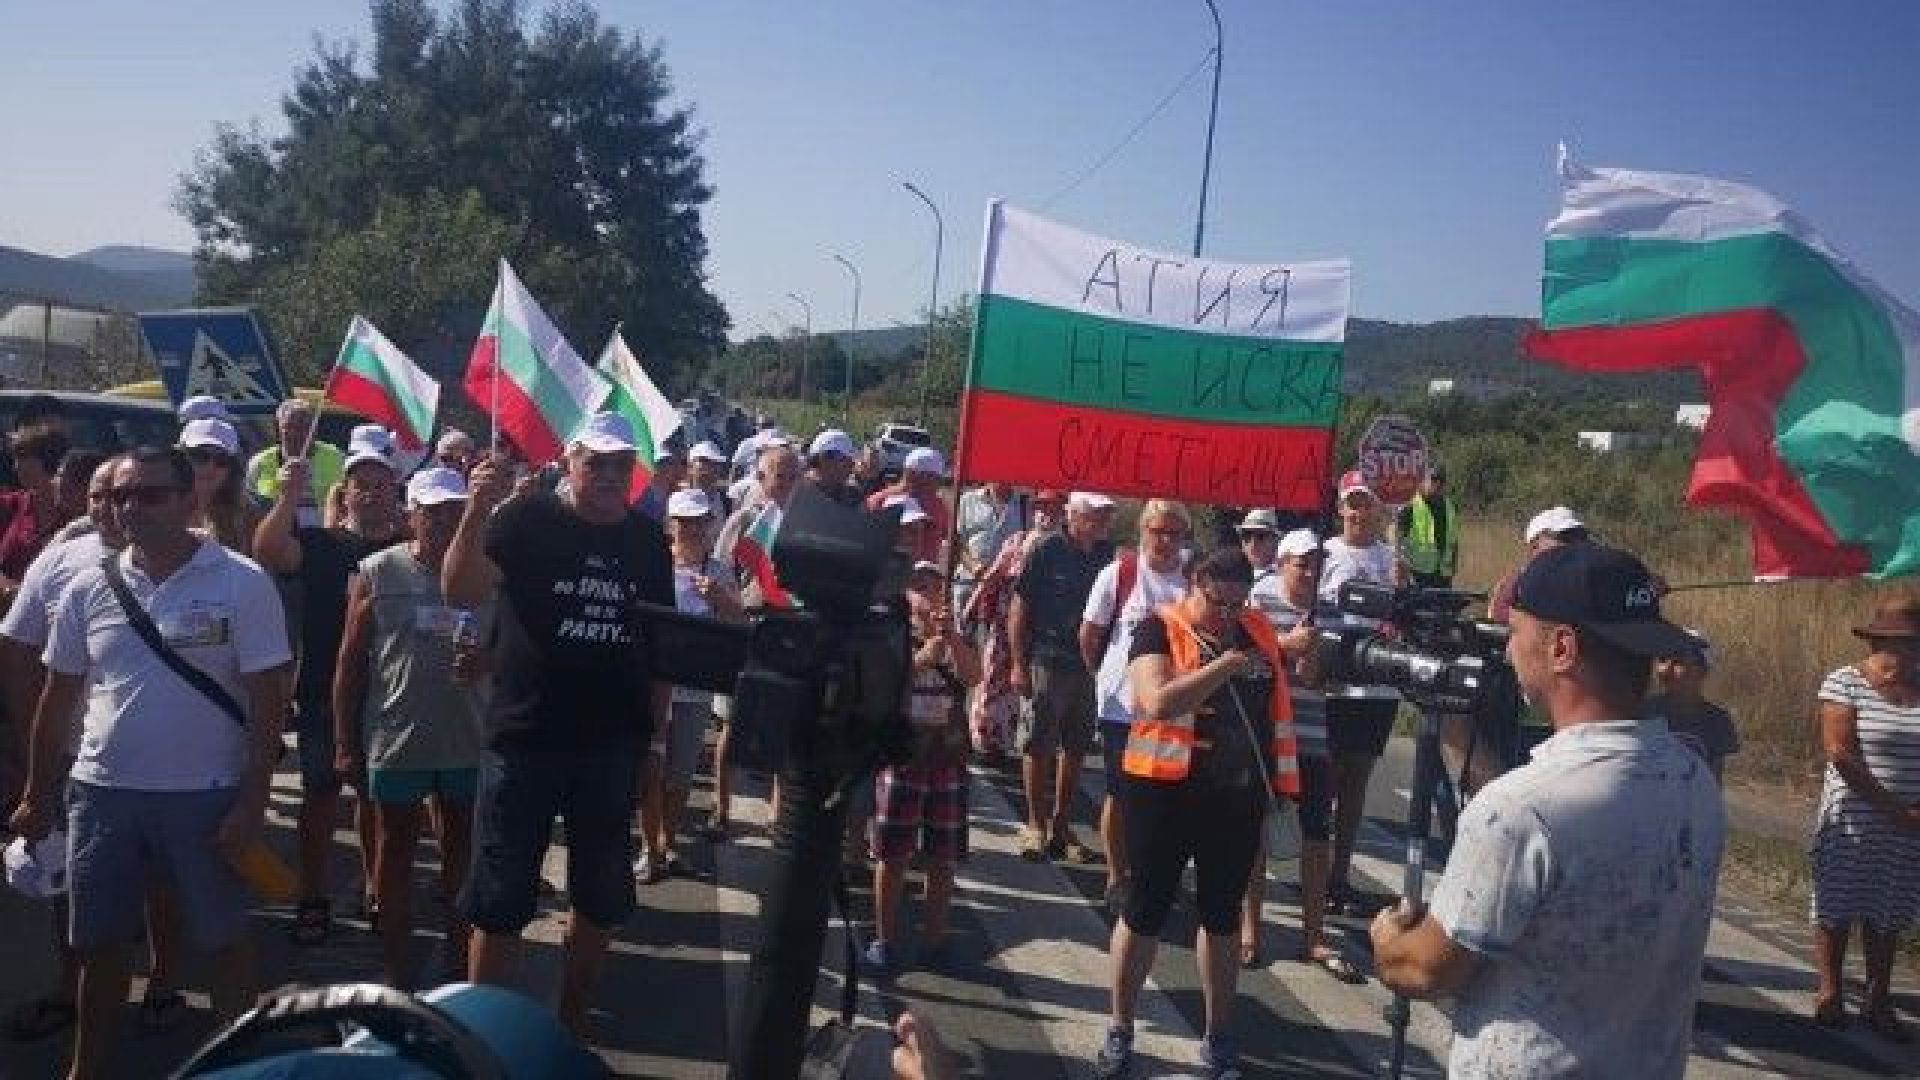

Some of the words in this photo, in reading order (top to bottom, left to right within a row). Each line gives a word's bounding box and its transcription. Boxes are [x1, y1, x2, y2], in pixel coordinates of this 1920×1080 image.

[1082, 249, 1291, 329] АТИЯ
[1070, 324, 1153, 399] НЕ
[1193, 346, 1344, 412] ИСКА
[1058, 417, 1323, 500] СМЕТИЩА
[1362, 449, 1423, 477] STOP
